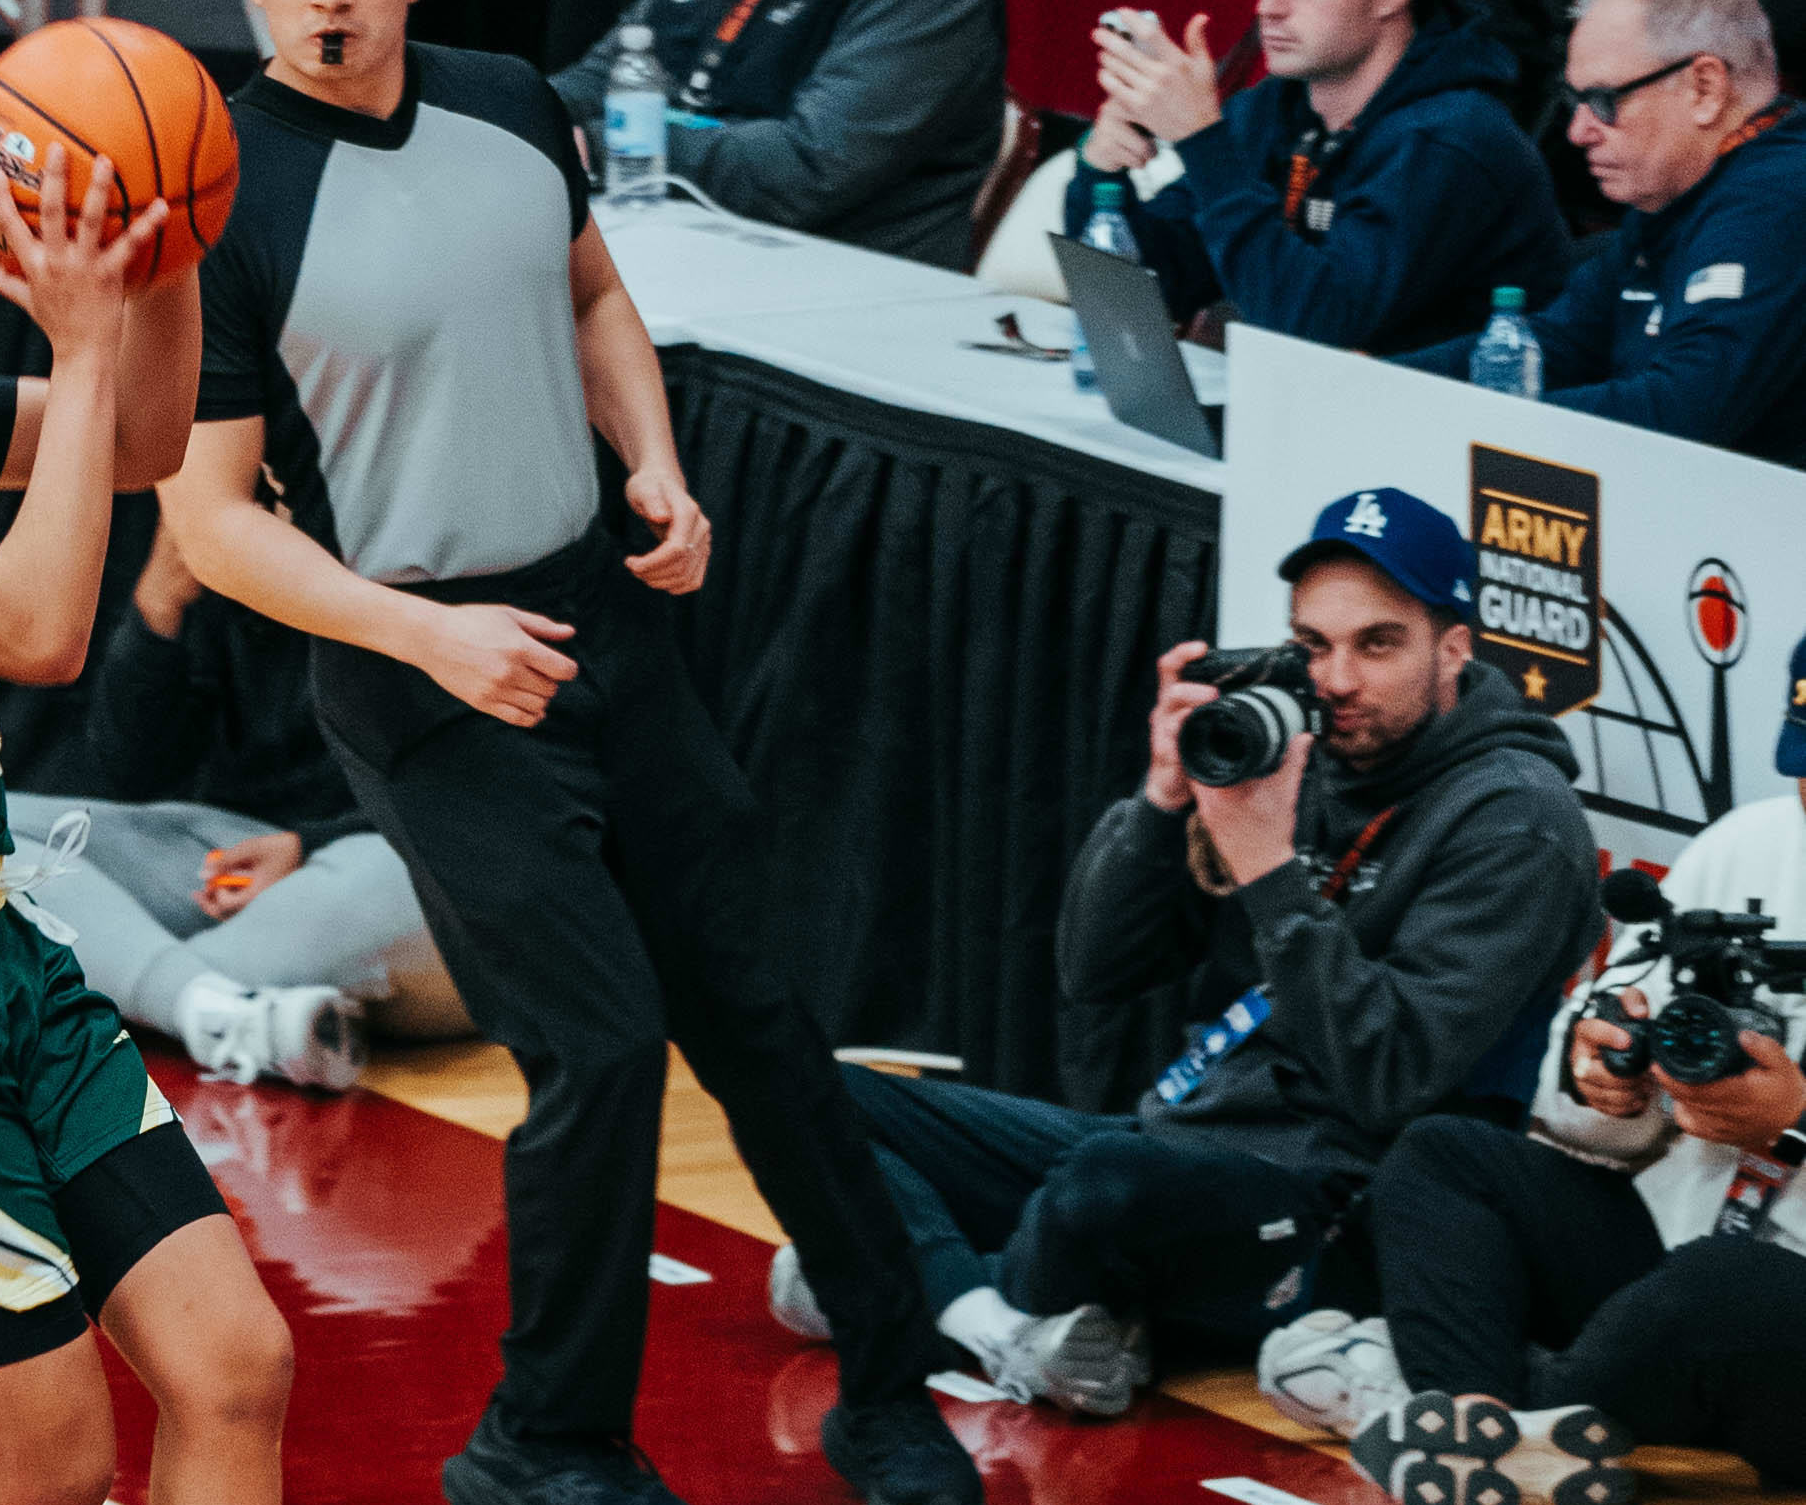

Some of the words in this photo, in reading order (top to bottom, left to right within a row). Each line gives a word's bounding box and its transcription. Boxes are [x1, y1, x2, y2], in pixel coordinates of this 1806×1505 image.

[1480, 503, 1588, 567] ARMY
[1479, 550, 1590, 605] NATIONAL
[1479, 584, 1590, 650] GUARD
